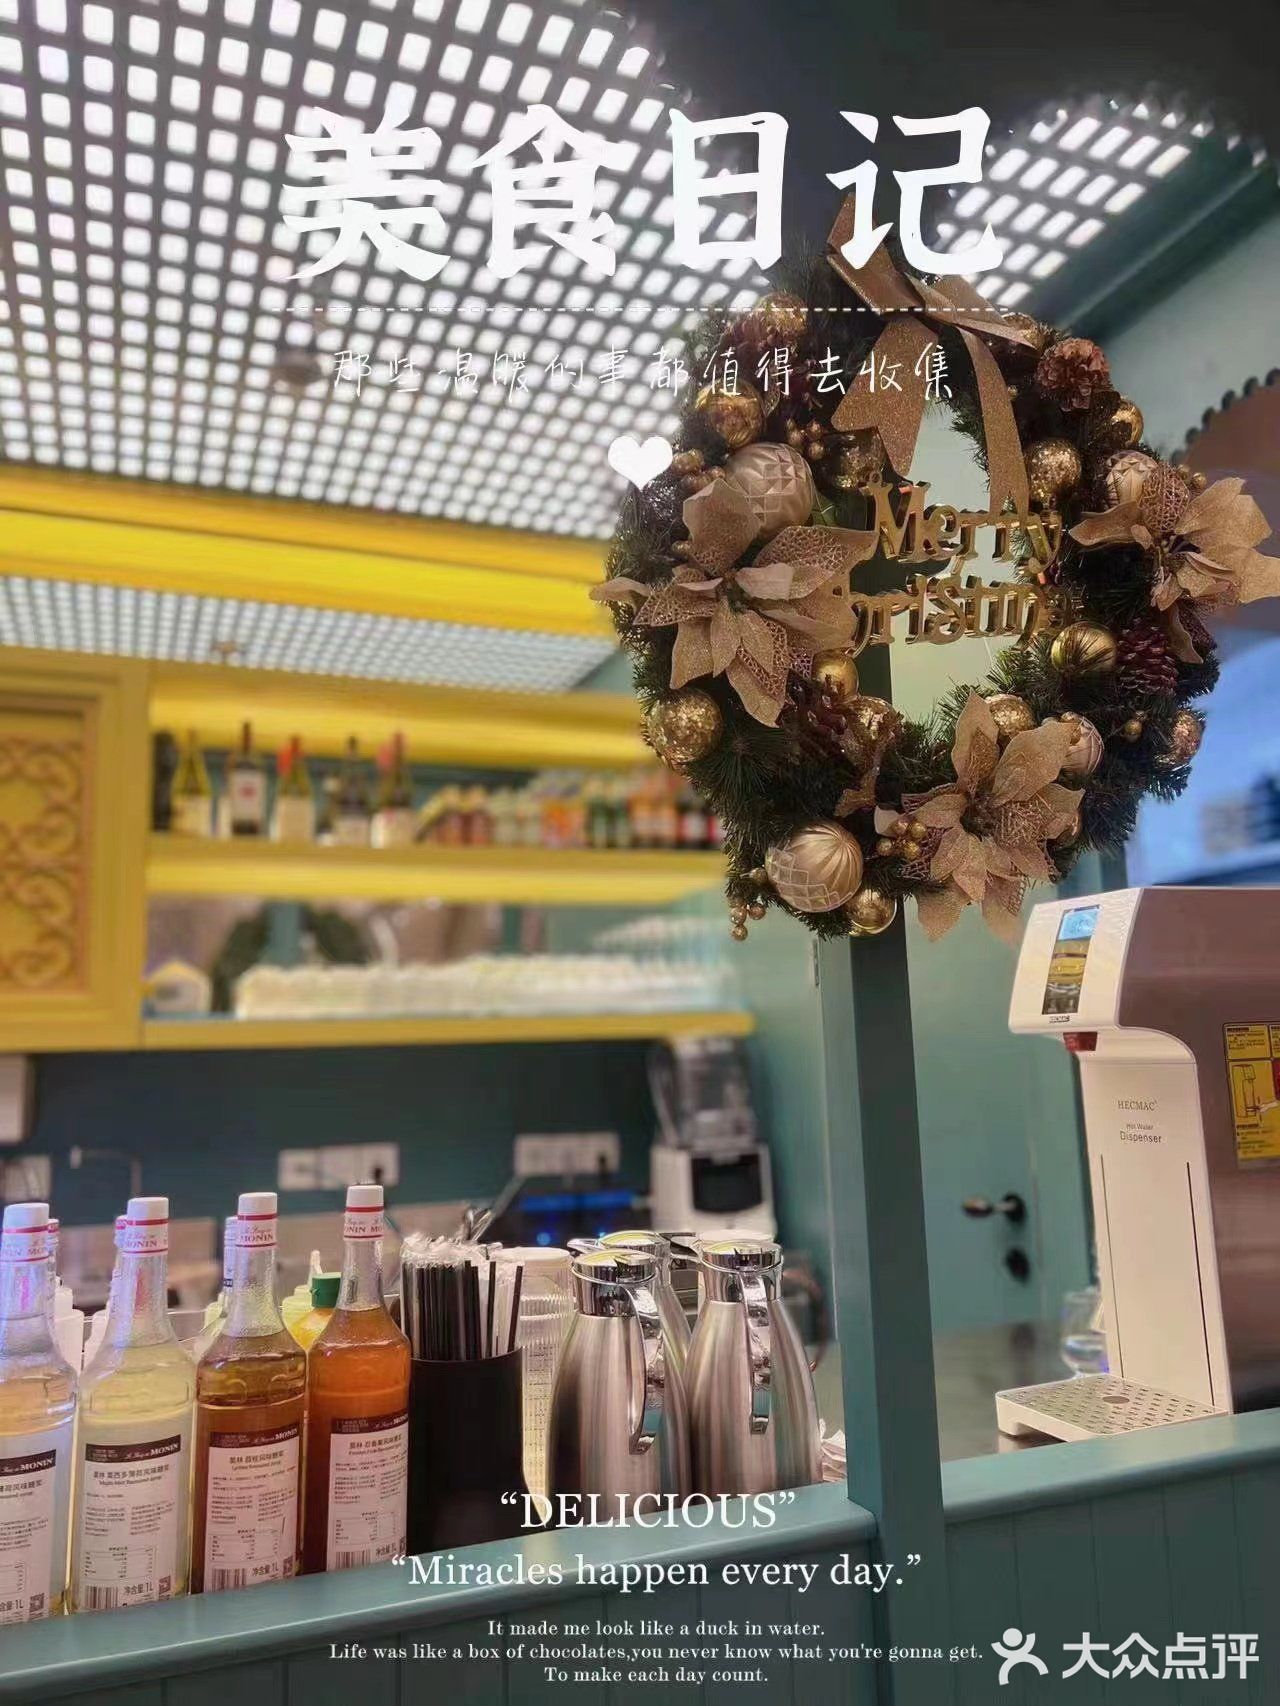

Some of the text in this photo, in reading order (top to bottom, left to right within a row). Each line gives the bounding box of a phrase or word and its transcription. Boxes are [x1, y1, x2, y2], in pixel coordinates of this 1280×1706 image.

[1119, 1130, 1161, 1143] Dispenser
[151, 1443, 179, 1456] MONIN
[20, 1457, 54, 1471] MONIN
